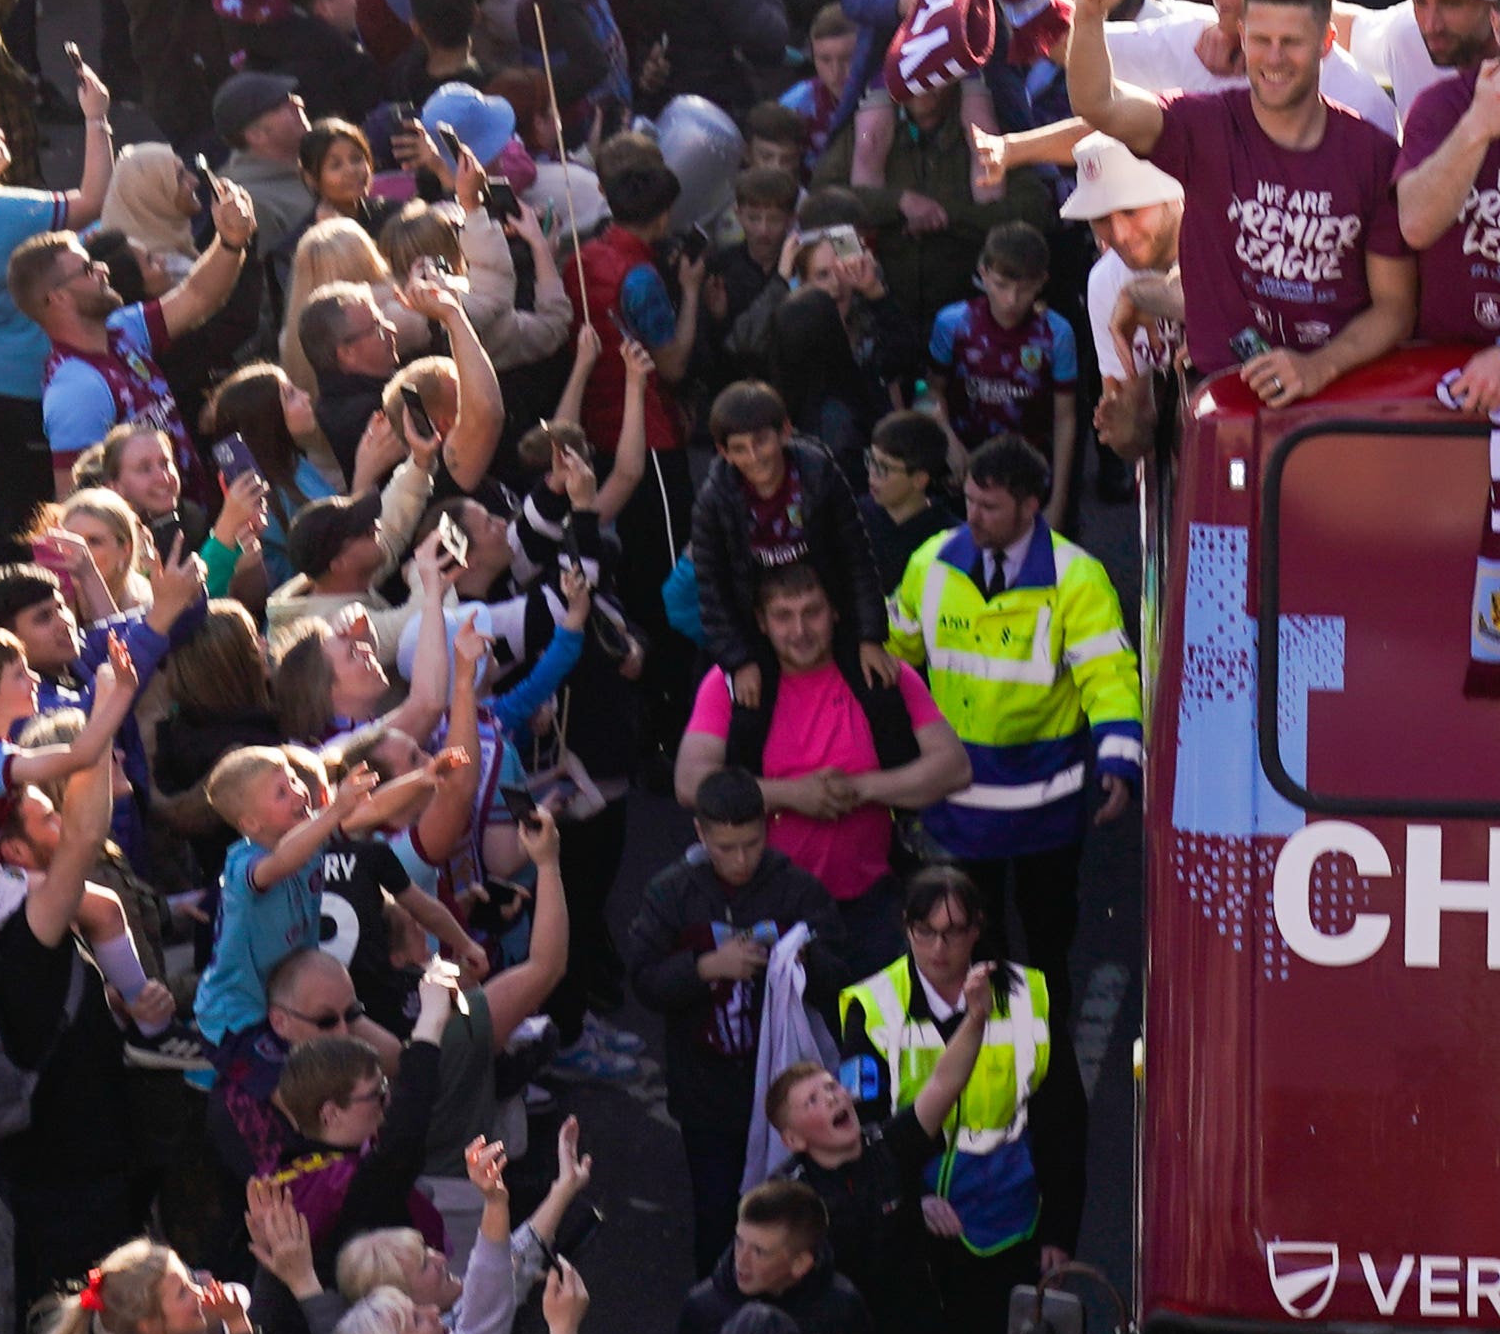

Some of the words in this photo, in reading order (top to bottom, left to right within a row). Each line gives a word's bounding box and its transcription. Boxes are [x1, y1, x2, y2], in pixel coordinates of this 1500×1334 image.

[1228, 193, 1362, 251] PREMIER
[1257, 179, 1286, 207] WE
[1287, 190, 1333, 217] ARE
[1235, 231, 1344, 283] LEAGUE
